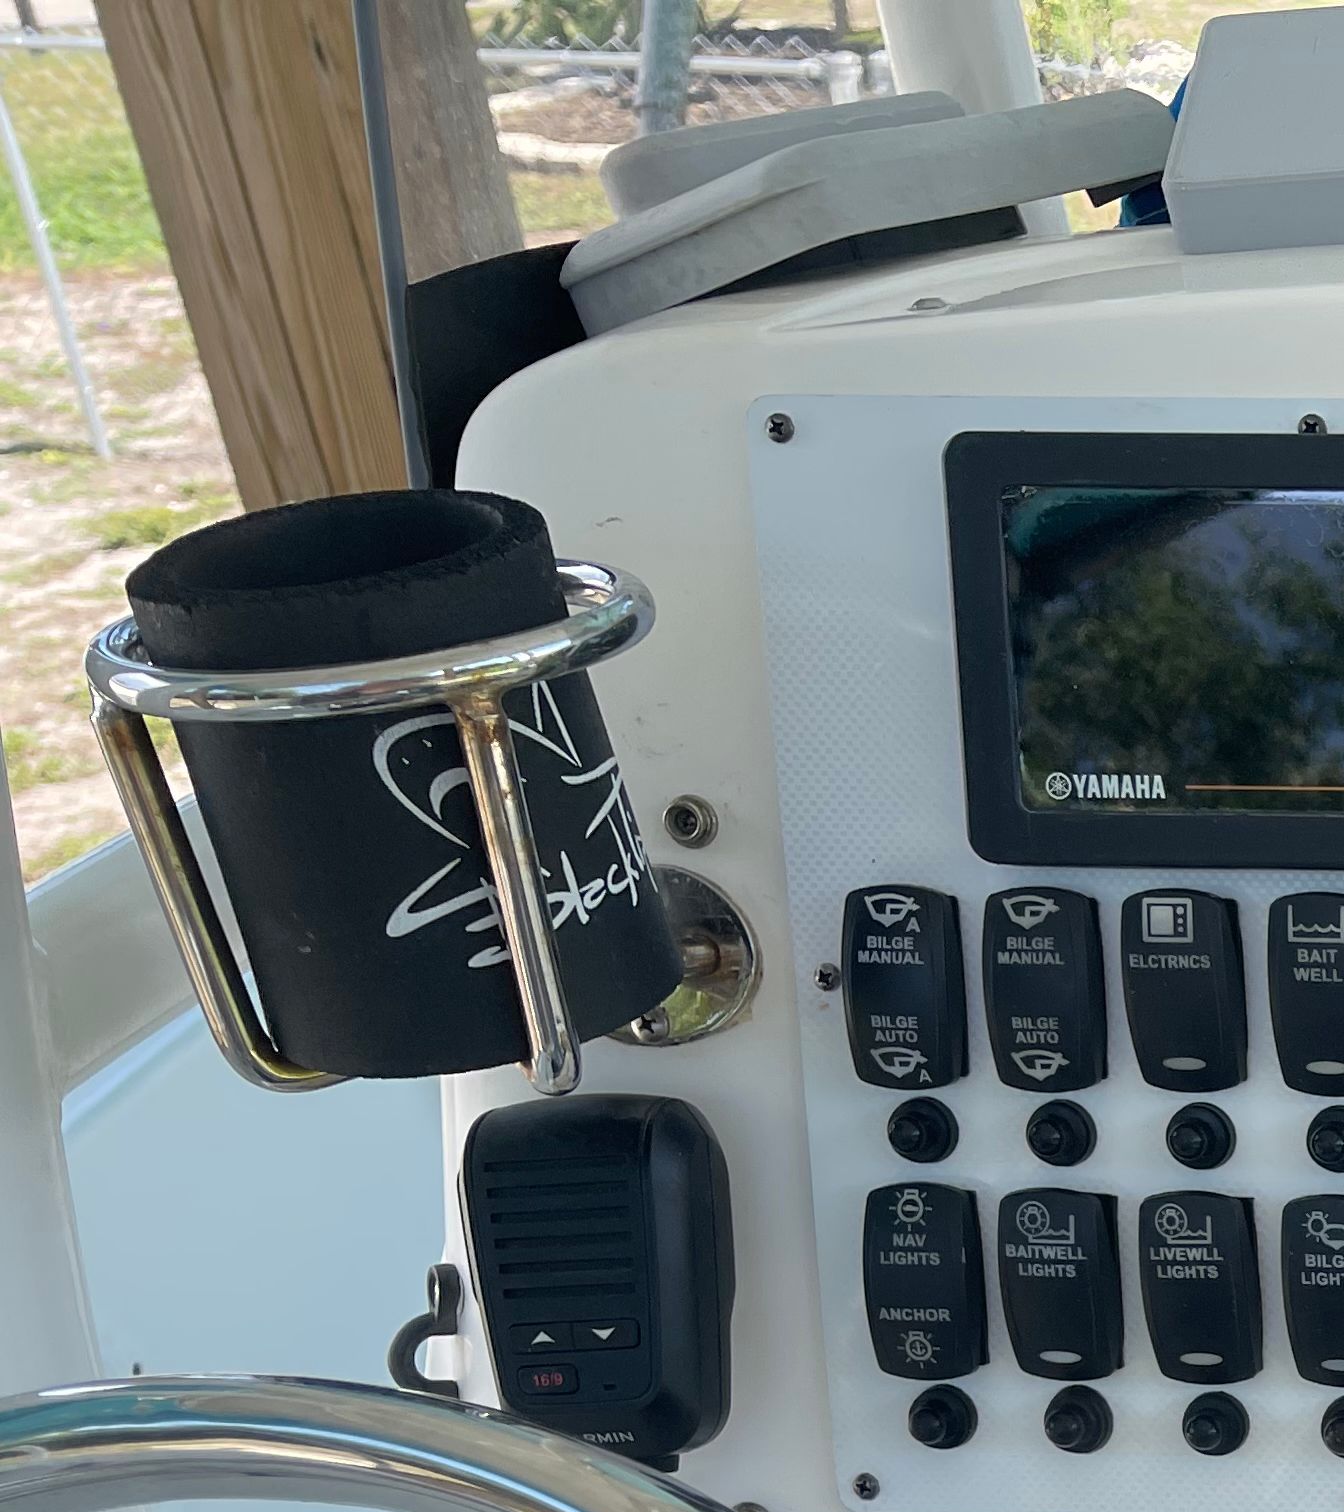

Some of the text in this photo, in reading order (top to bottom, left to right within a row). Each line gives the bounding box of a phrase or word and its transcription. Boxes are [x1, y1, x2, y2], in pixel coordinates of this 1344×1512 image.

[1072, 774, 1167, 801] YAMAHA
[905, 917, 920, 933] A
[866, 936, 914, 950] BILGE
[1006, 936, 1055, 951] BILGE
[857, 950, 924, 965] MANUAL
[997, 952, 1064, 966] MANUAL
[1129, 954, 1211, 970] ELCTRNCS
[1296, 949, 1338, 965] BAIT
[1293, 967, 1343, 983] WELL
[870, 1015, 918, 1030] BILGE
[1011, 1016, 1059, 1031] BILGE
[874, 1030, 918, 1044] AUTO
[1015, 1030, 1059, 1045] AUTO
[919, 1069, 932, 1084] A
[893, 1233, 926, 1248] NAV
[880, 1252, 940, 1266] LIGHTS
[1005, 1244, 1088, 1261] BAITWELL
[1150, 1247, 1224, 1262] LIVEWLL
[1018, 1263, 1076, 1278] LIGHTS
[1157, 1264, 1219, 1280] LIGHTS
[879, 1307, 951, 1322] ANCHOR
[533, 1373, 563, 1387] 16/9
